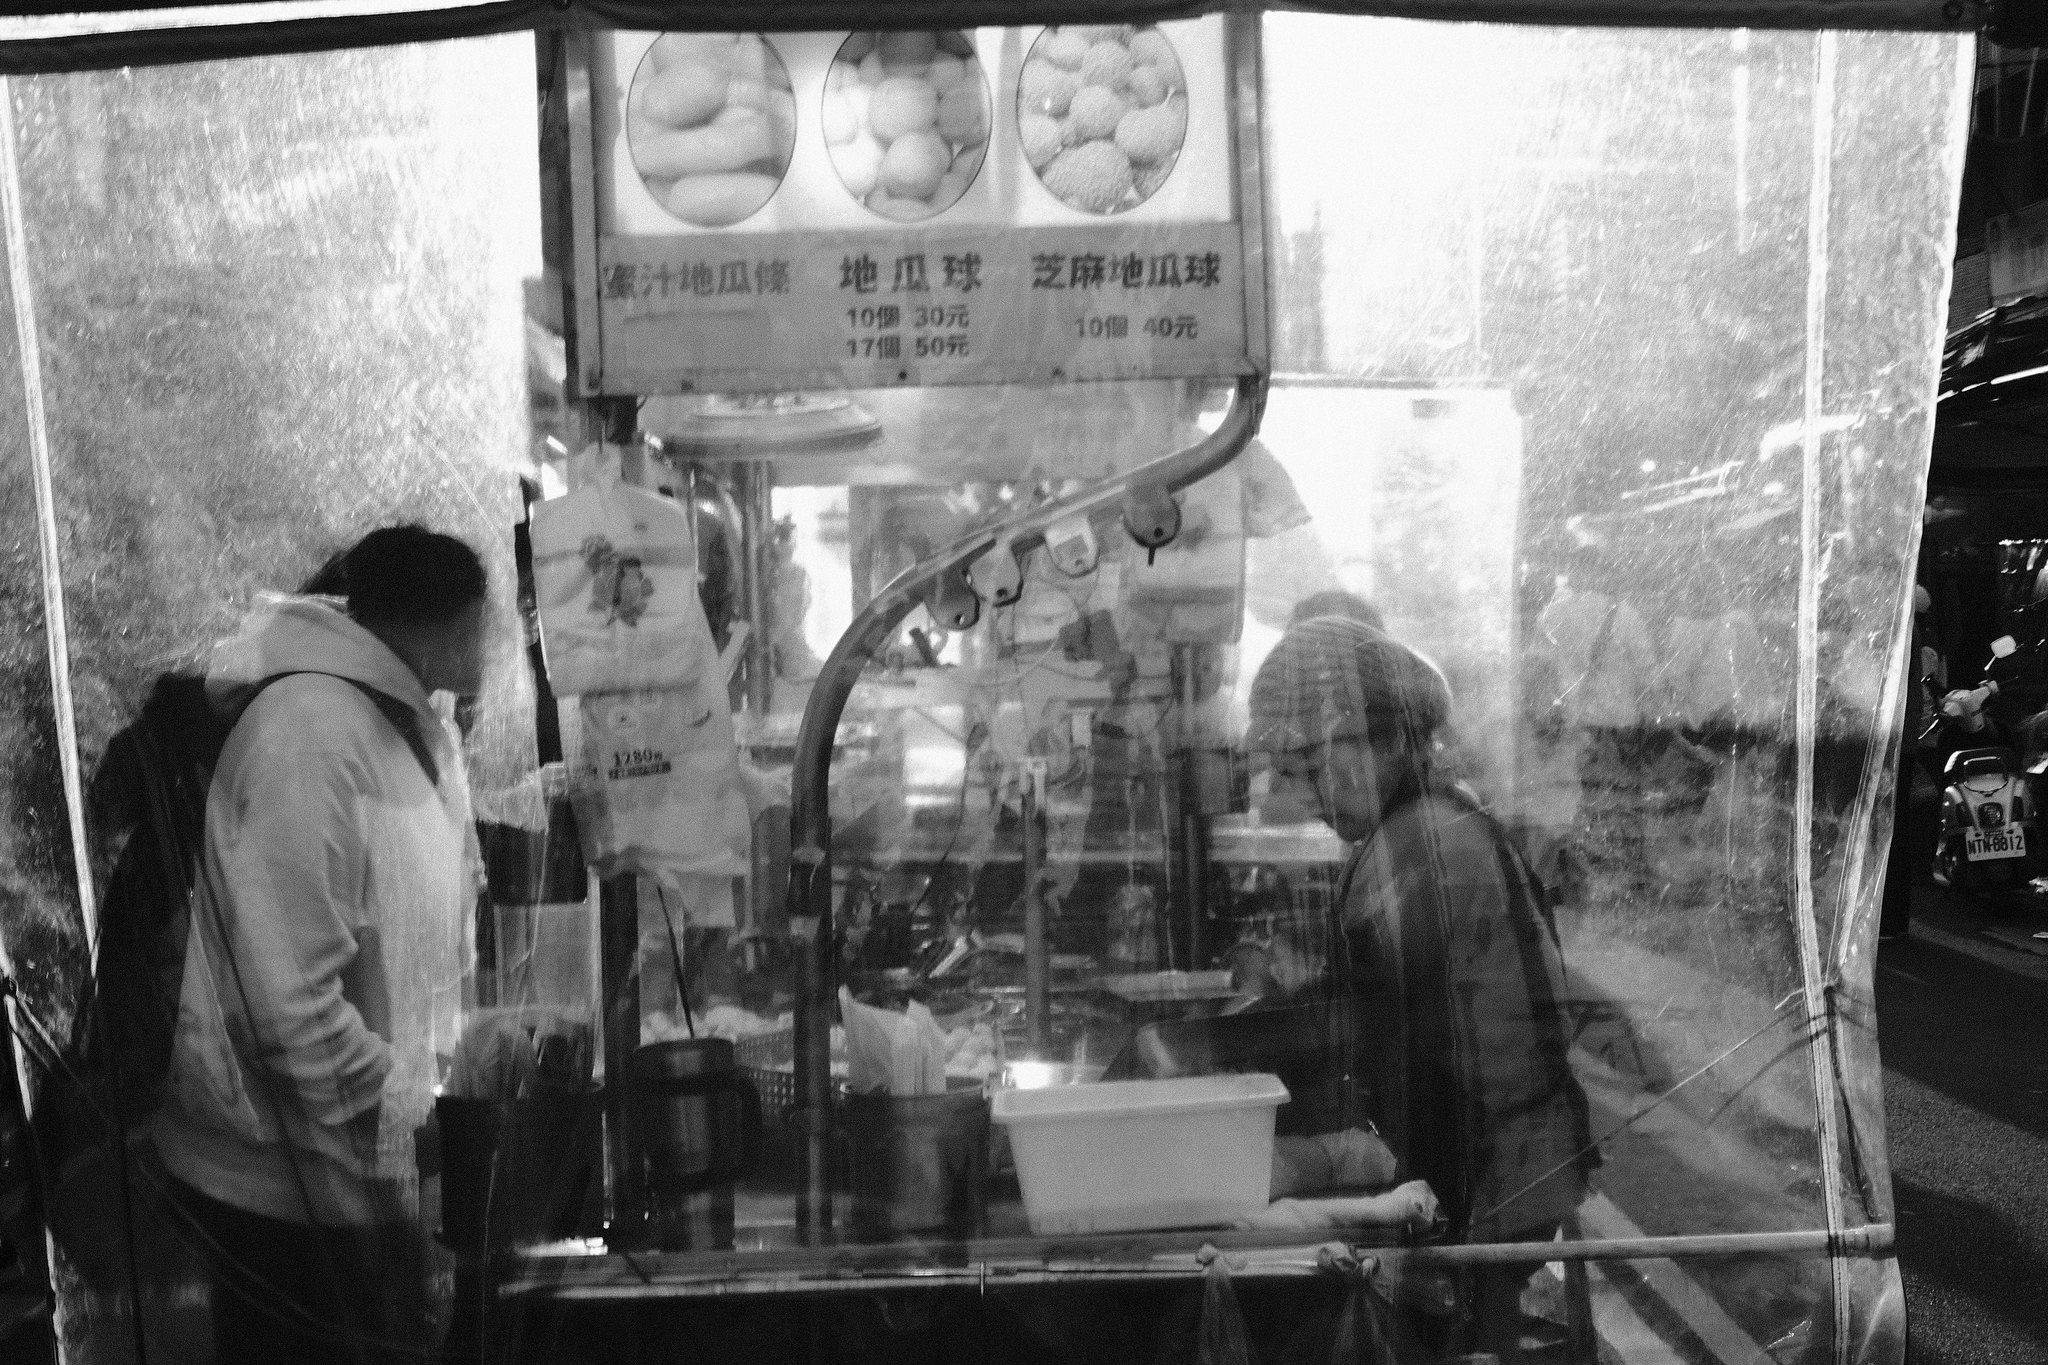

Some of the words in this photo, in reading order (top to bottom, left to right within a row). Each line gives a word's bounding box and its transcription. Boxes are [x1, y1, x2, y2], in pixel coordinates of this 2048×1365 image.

[839, 252, 983, 293] 地瓜球
[1031, 251, 1221, 290] 芝麻地瓜球
[847, 304, 901, 330] 10個
[914, 304, 970, 328] 30元
[1074, 313, 1129, 340] 10個
[1143, 313, 1199, 340] 40元
[847, 335, 901, 360] 17個
[914, 333, 970, 358] 50元
